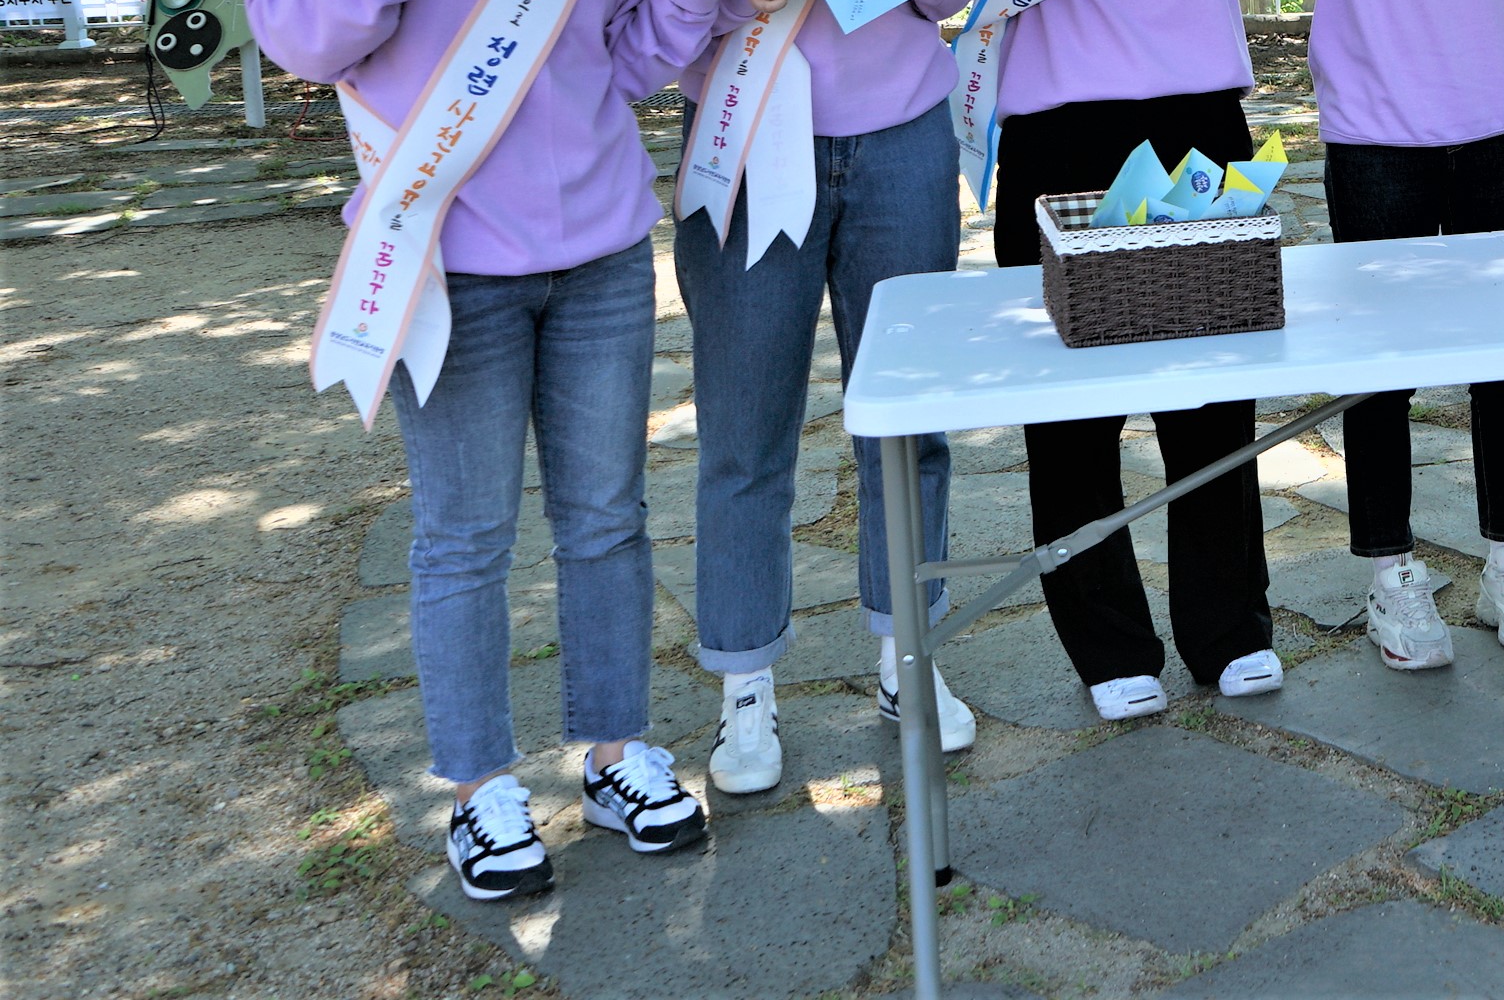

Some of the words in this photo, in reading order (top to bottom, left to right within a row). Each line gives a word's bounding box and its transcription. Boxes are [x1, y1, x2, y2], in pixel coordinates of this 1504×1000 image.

[467, 36, 518, 96] 청렴
[713, 85, 740, 149] 꿈꾸다
[963, 72, 982, 128] 꿈꾸다
[360, 241, 395, 315] 꿈꾸다
